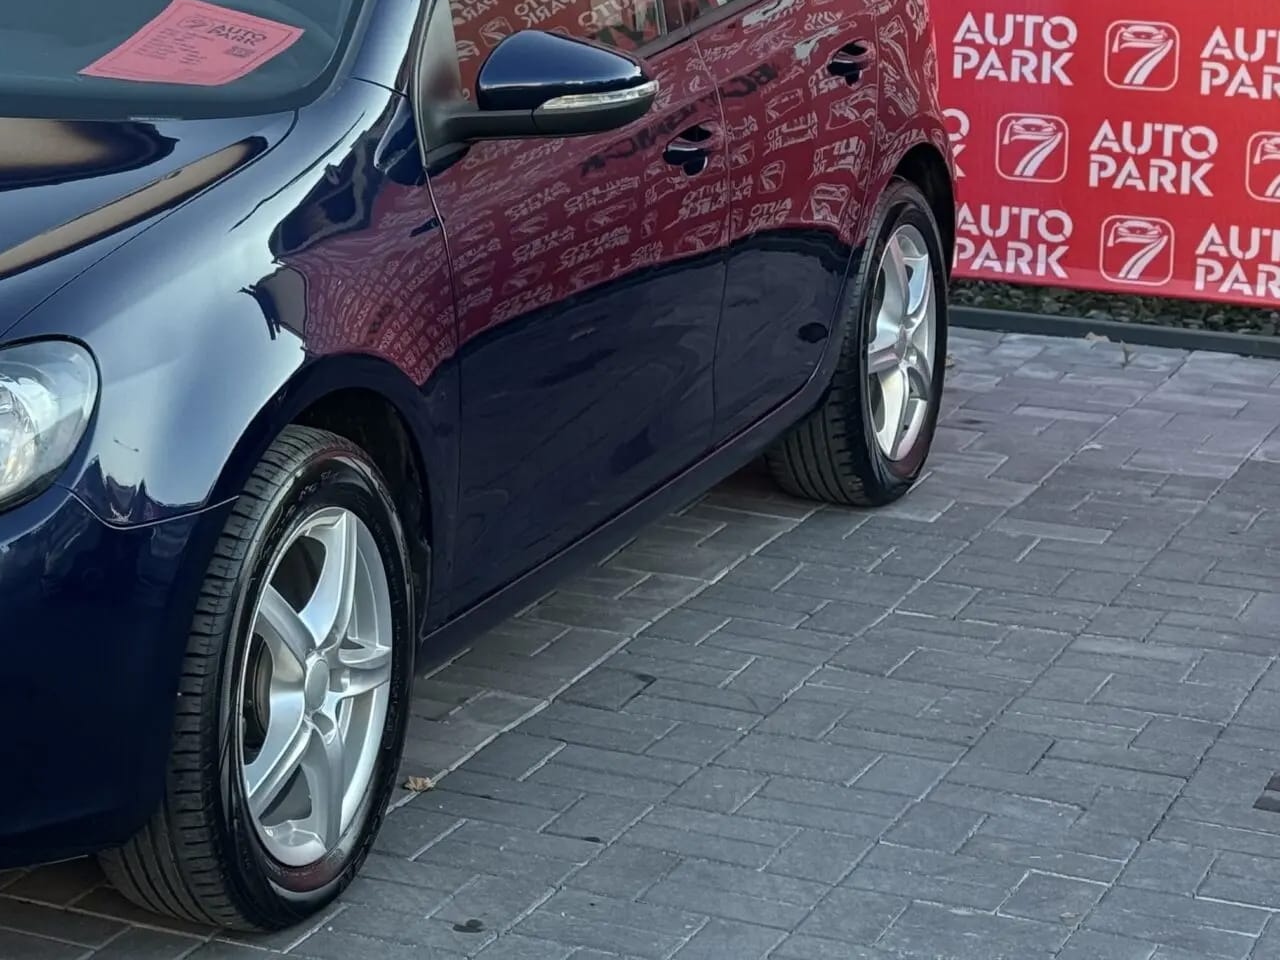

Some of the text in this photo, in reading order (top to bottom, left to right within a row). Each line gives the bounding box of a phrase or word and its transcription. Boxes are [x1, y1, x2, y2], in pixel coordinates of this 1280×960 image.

[952, 11, 1077, 50] AUTO
[952, 46, 1074, 86] PARK
[1089, 119, 1218, 160] AUTO
[1089, 154, 1214, 197] PARK
[956, 202, 1073, 243] AUTO
[954, 238, 1070, 279] PARK
